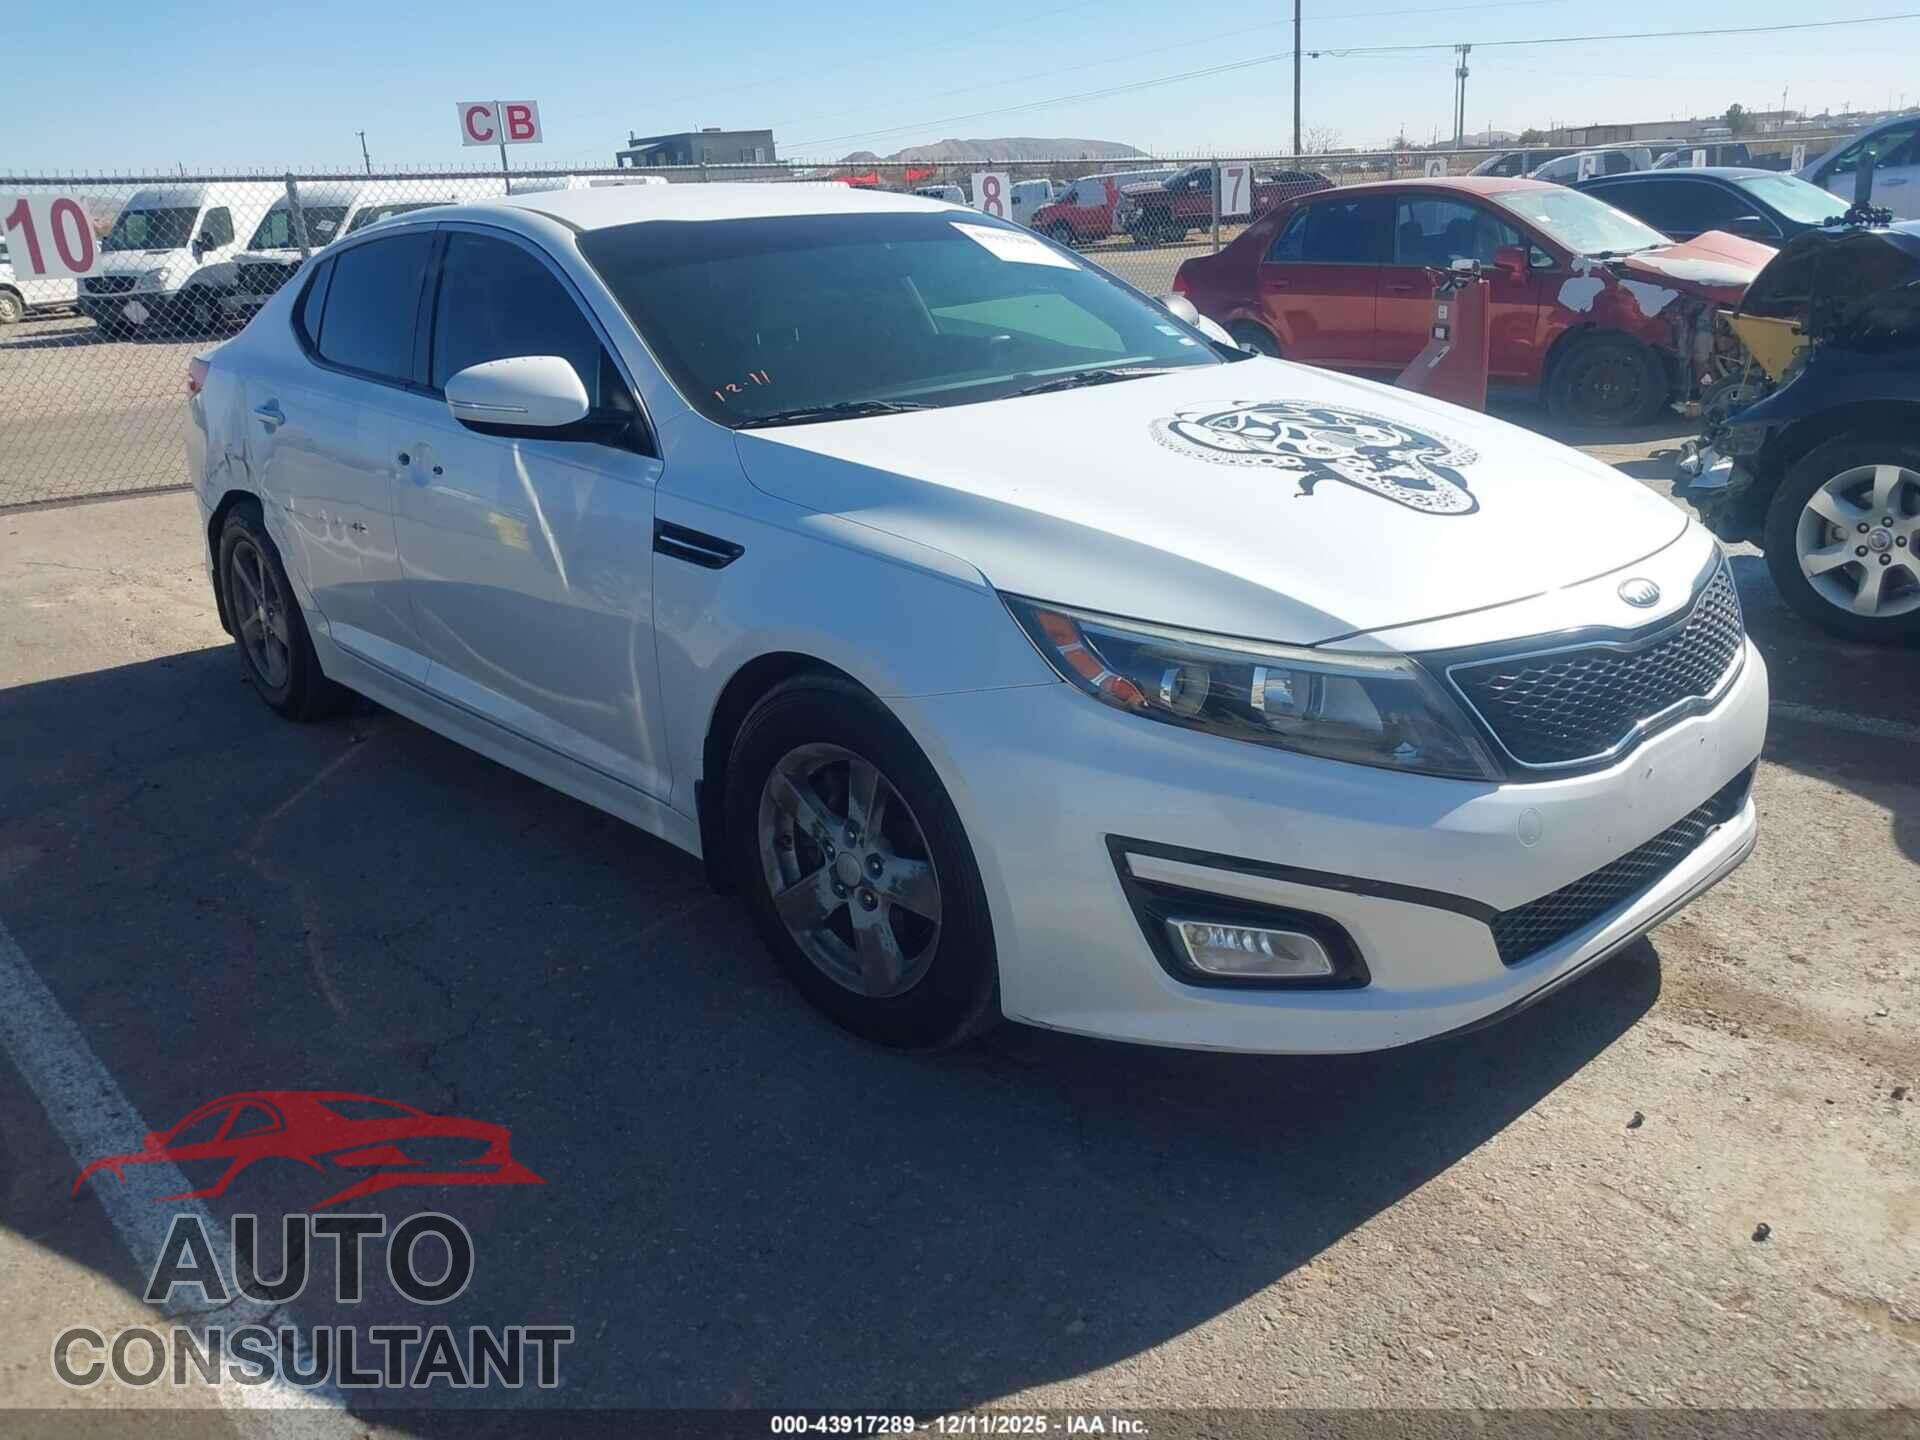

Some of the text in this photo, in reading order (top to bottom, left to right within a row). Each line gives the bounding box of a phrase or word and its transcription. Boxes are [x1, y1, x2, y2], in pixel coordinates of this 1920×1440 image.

[466, 105, 535, 142] C B
[981, 175, 1004, 219] 8
[1227, 169, 1244, 212] 7
[5, 197, 95, 275] 10
